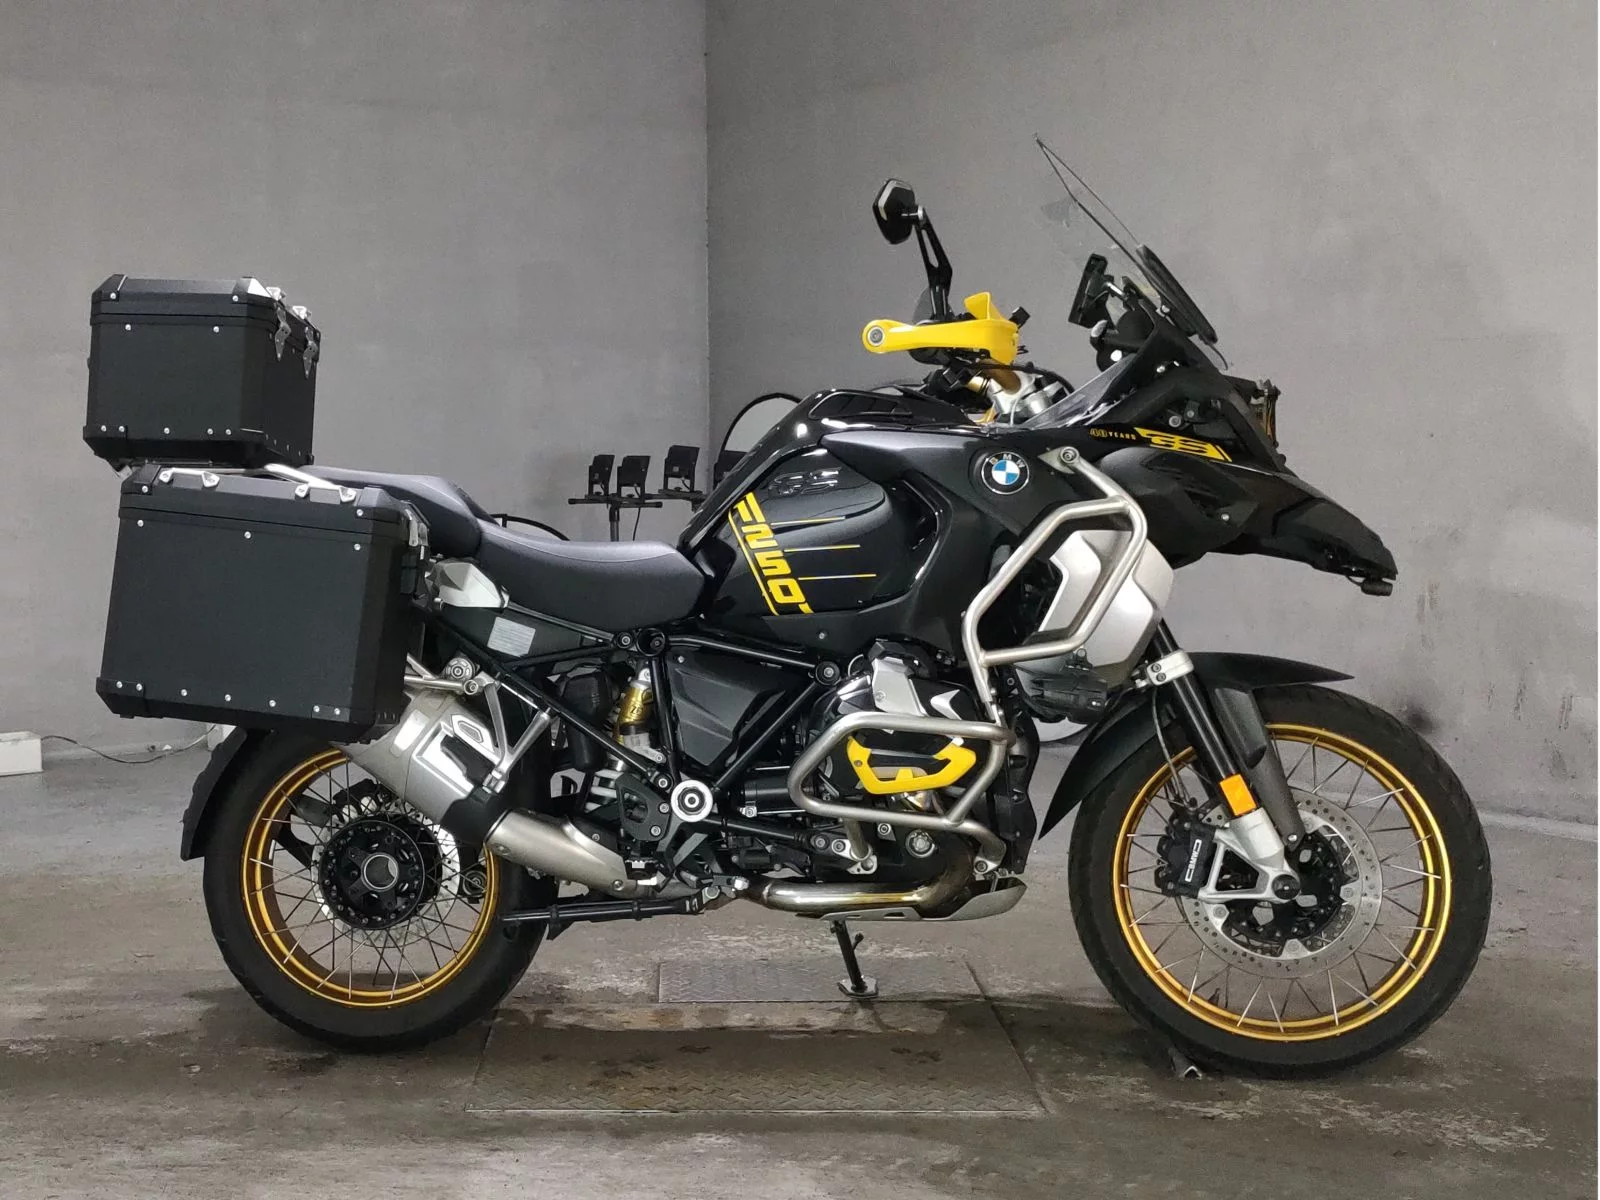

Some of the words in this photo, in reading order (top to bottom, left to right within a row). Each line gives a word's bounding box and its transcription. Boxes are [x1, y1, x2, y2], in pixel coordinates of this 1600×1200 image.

[1108, 431, 1136, 441] YEARS
[1134, 427, 1226, 461] GS
[989, 453, 1025, 468] BMW
